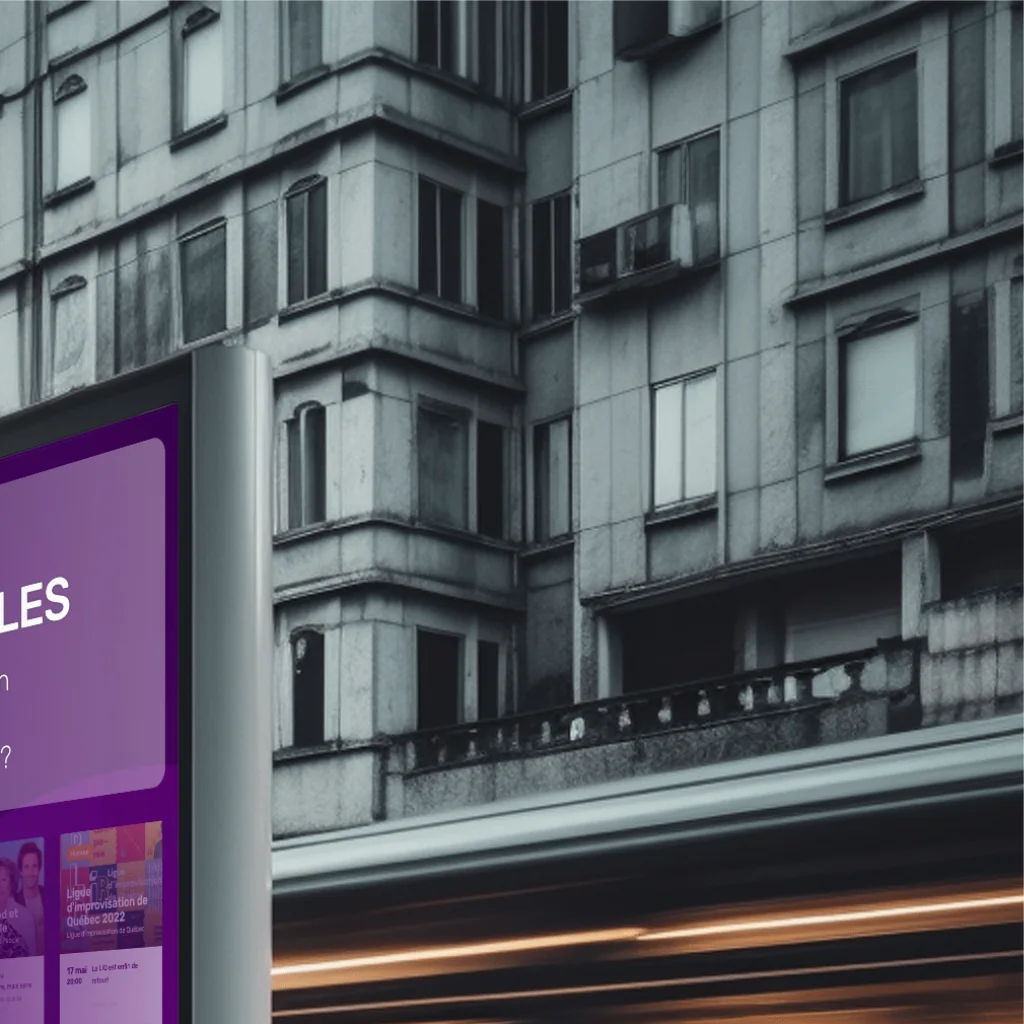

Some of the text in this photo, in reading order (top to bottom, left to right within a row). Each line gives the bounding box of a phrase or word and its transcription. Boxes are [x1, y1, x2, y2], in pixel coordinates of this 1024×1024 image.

[66, 887, 91, 902] Ligue
[66, 897, 136, 913] d'improvisation
[136, 894, 148, 906] de
[8, 907, 19, 918] et
[66, 911, 126, 928] Québec 2022
[66, 965, 87, 974] 17 mai
[66, 977, 83, 985] 20:00
